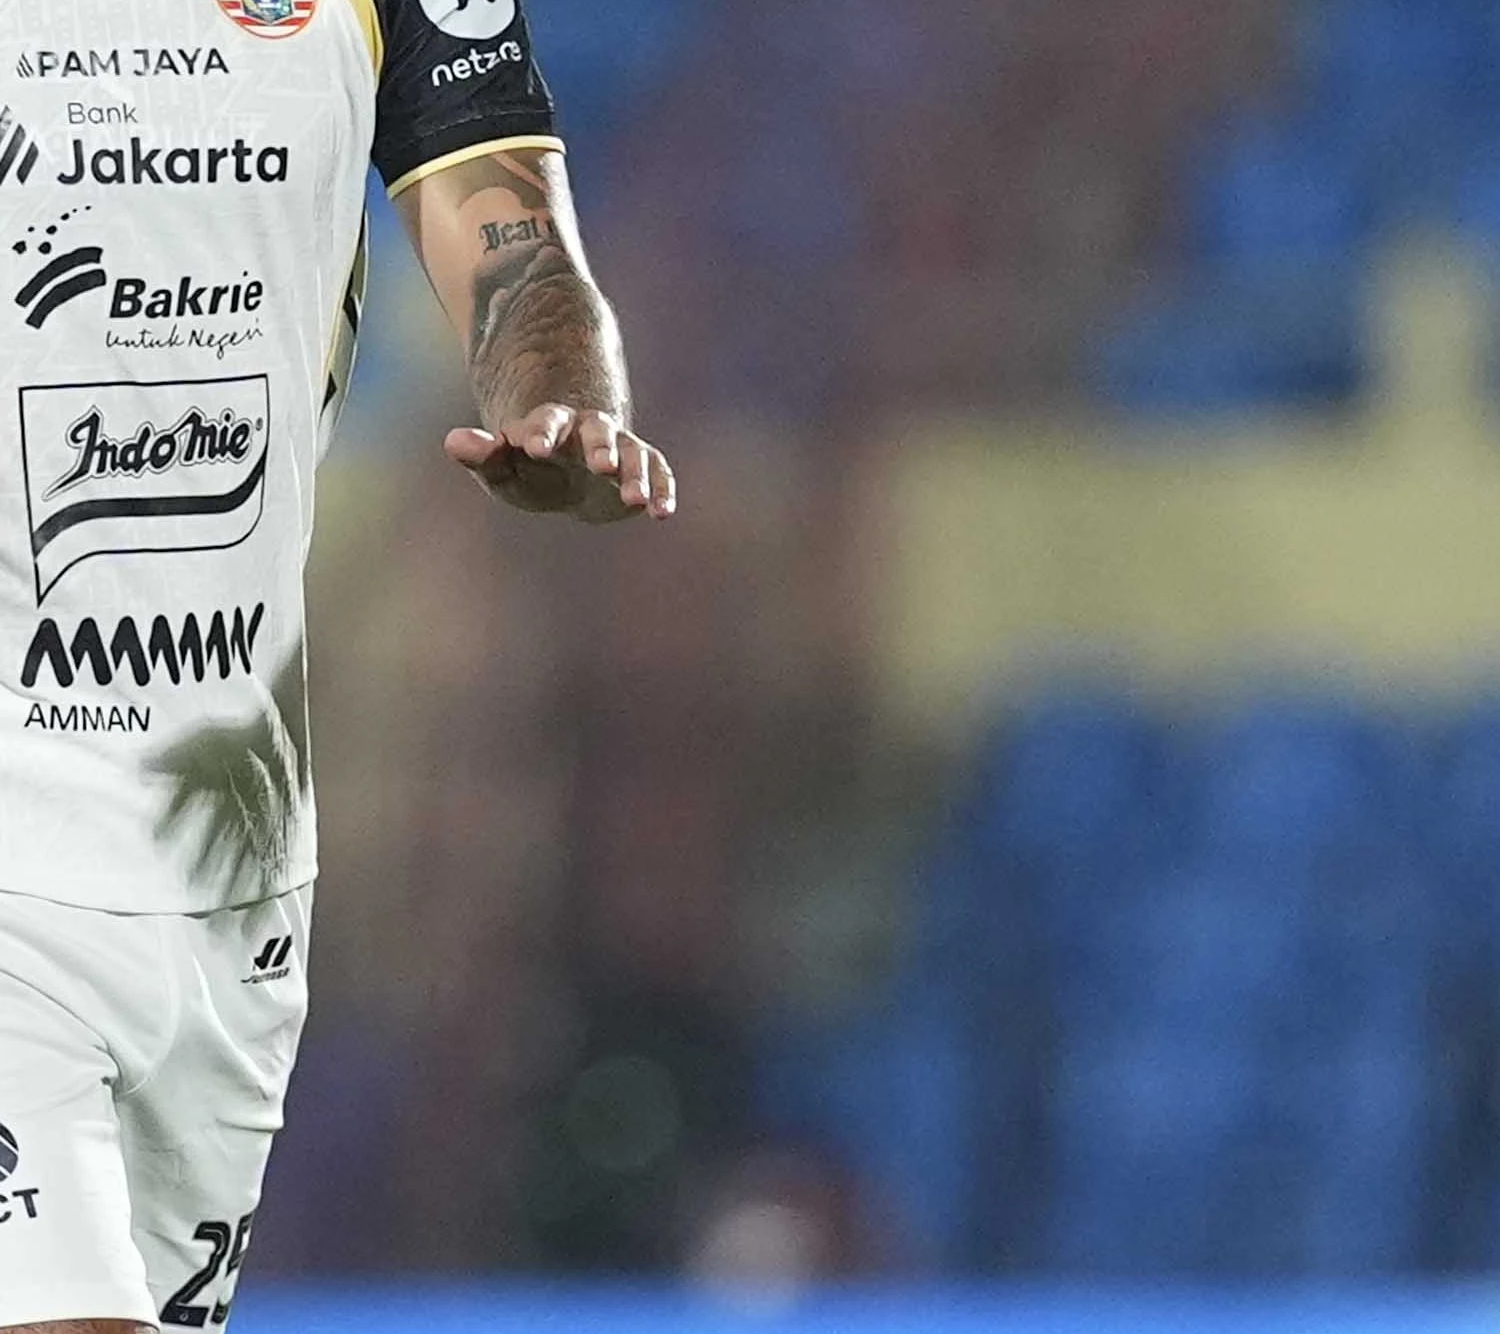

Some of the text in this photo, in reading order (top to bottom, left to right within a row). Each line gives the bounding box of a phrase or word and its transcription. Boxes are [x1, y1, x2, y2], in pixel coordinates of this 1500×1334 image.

[36, 47, 230, 78] PAM JAYA
[66, 101, 139, 125] Bank
[56, 136, 290, 186] Jakarta
[108, 270, 264, 319] Bakrie
[23, 703, 151, 733] AMMAN
